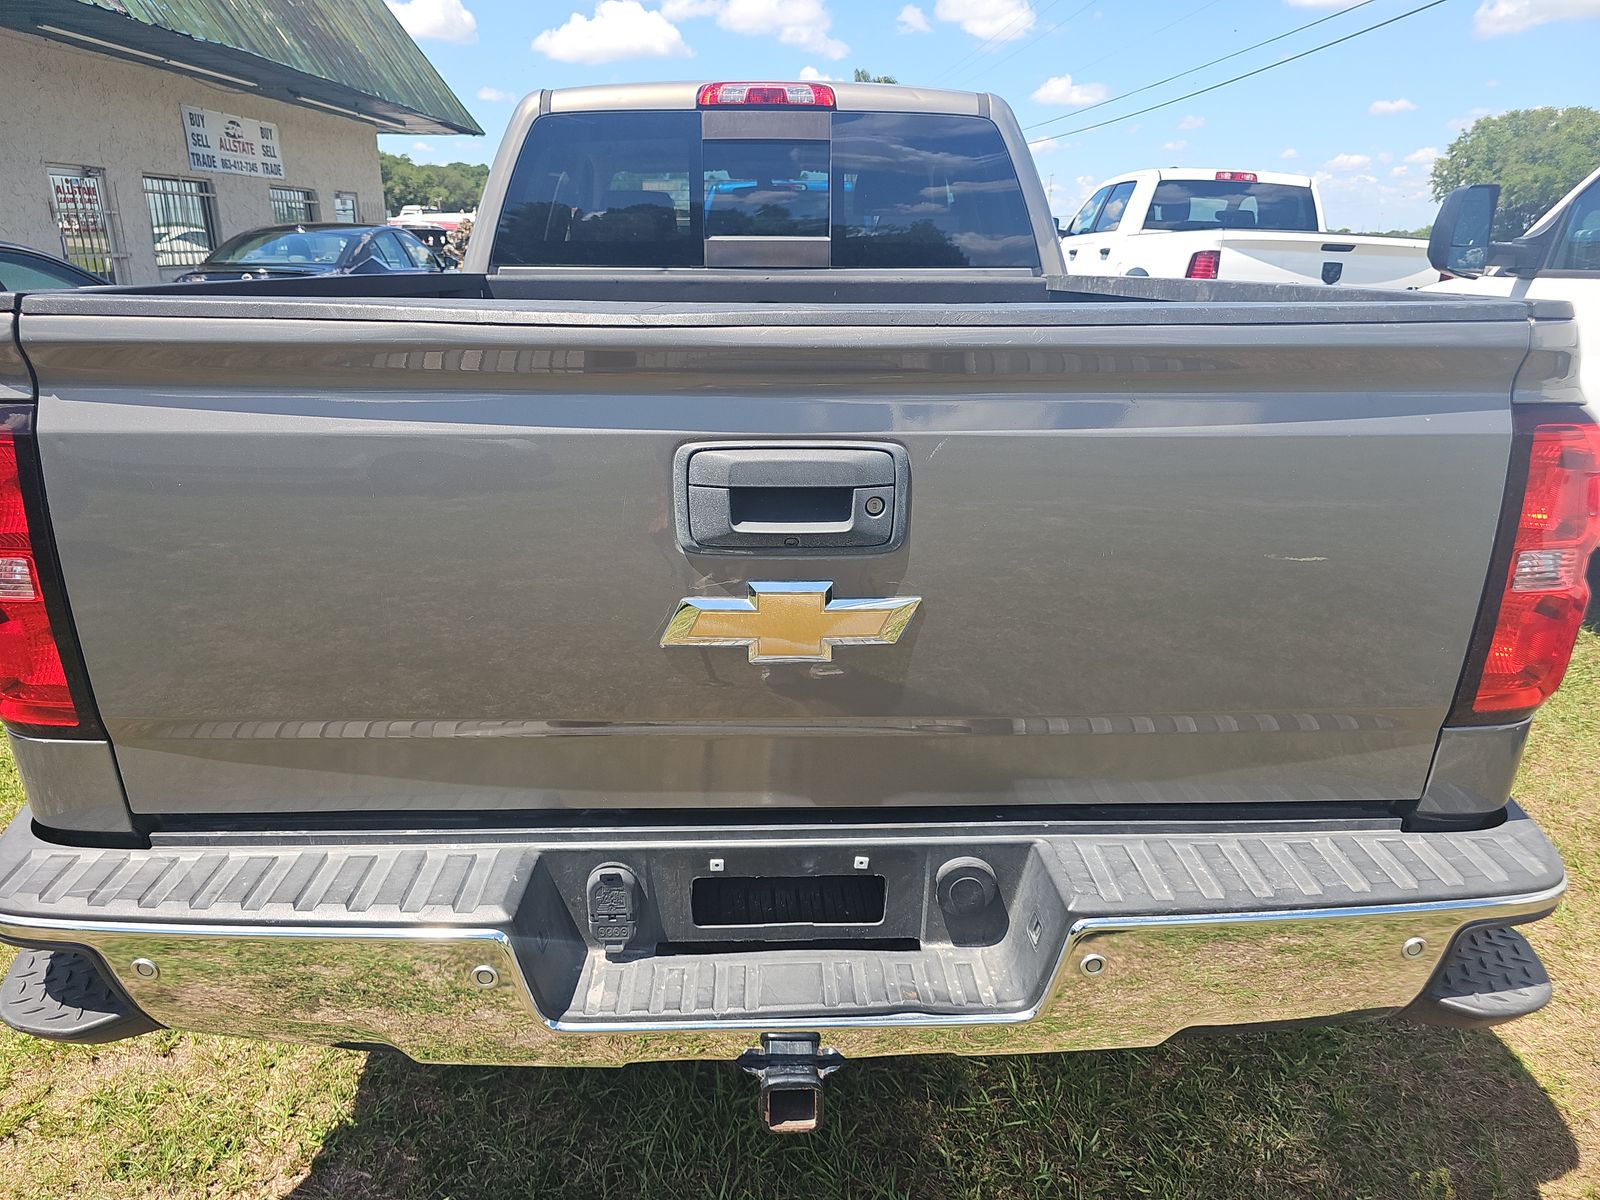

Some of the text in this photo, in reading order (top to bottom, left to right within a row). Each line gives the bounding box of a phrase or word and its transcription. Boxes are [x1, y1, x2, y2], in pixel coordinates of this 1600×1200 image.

[189, 112, 205, 128] BUY
[191, 132, 211, 149] SELL
[260, 127, 273, 140] BUY
[219, 137, 255, 155] ALLSTATE
[261, 145, 277, 159] SELL
[191, 152, 218, 169] TRADE
[261, 162, 283, 177] TRADE
